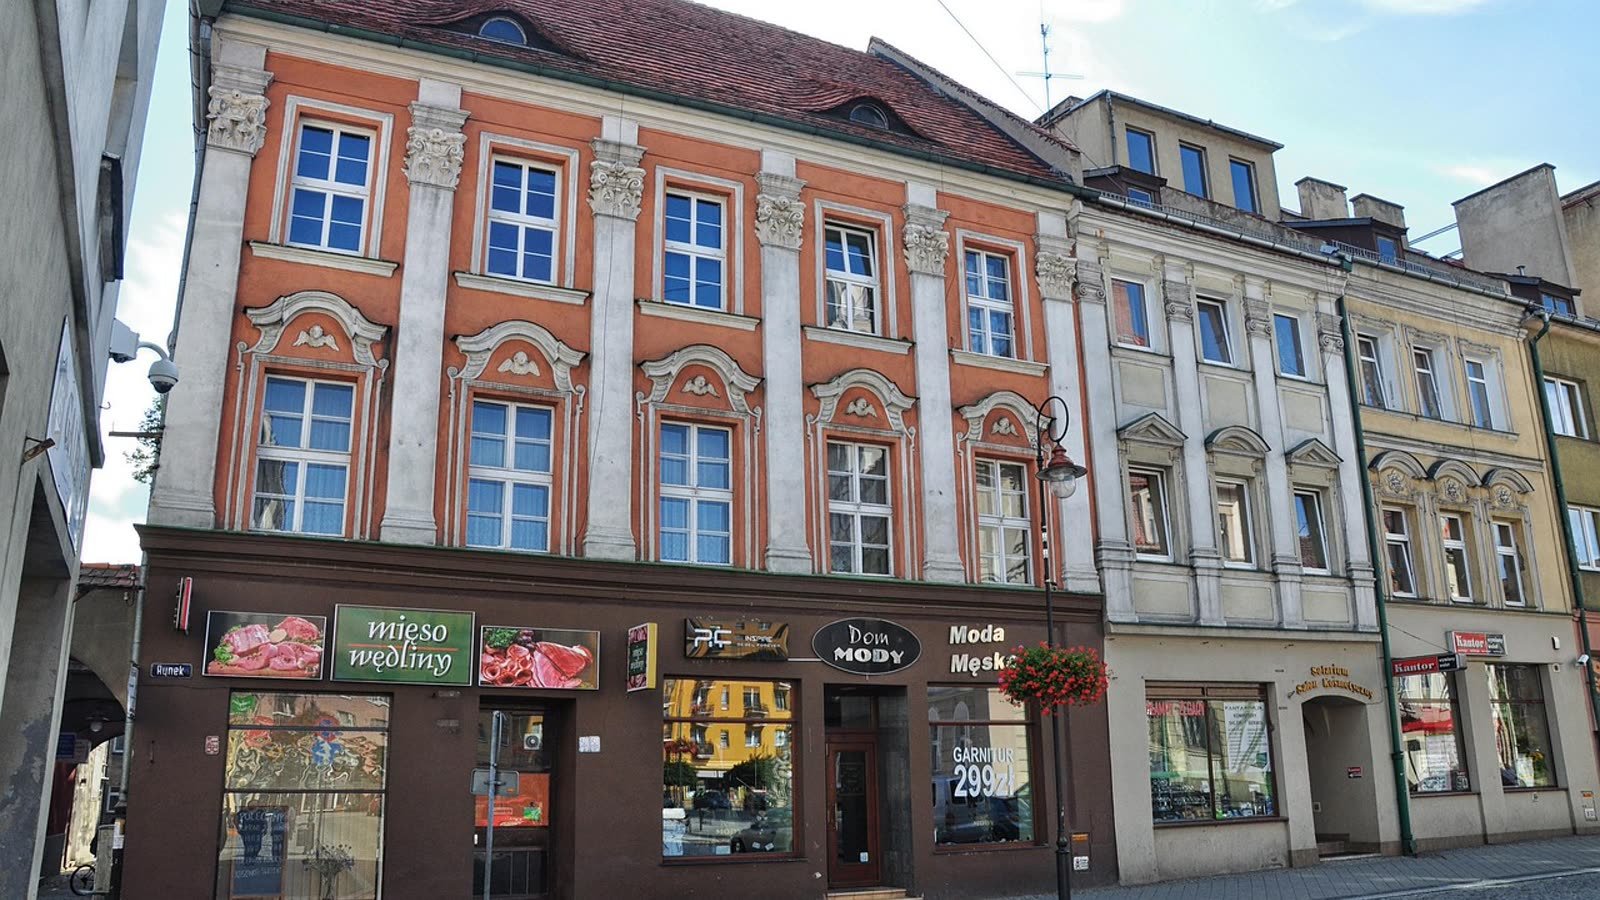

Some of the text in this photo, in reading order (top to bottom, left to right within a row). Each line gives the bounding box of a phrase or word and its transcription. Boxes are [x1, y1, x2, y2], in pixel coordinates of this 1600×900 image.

[368, 614, 447, 645] mięso
[849, 624, 889, 646] Dom
[950, 624, 1005, 645] Moda
[1455, 634, 1485, 649] Kantor
[349, 640, 451, 677] wędliny
[834, 647, 904, 664] MODY
[156, 664, 185, 677] Rynek
[1395, 661, 1435, 673] Kantor
[953, 746, 1015, 763] GARNITUR
[953, 764, 1015, 798] 299zł
